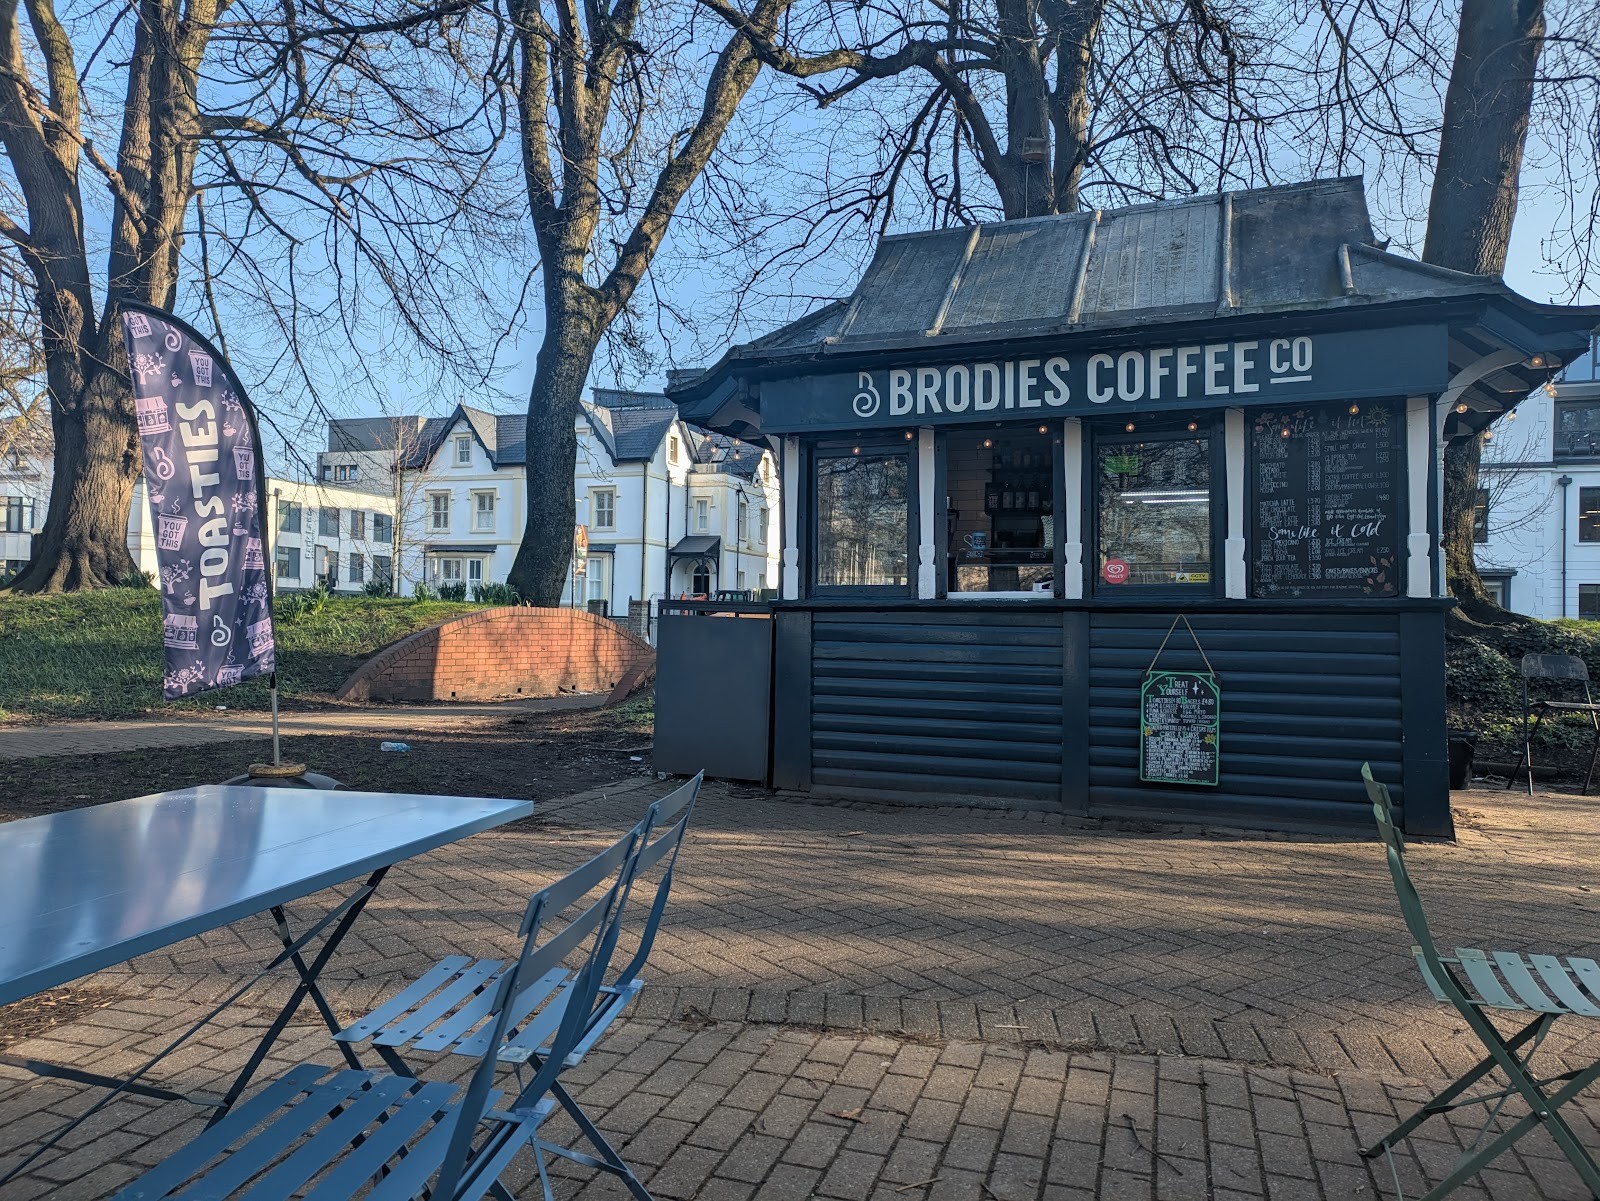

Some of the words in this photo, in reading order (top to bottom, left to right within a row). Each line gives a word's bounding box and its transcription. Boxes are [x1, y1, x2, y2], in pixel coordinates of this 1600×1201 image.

[131, 325, 150, 335] THIS
[195, 357, 209, 367] YOU
[196, 367, 210, 376] GOT
[889, 356, 1071, 416] BRODIES
[1086, 340, 1260, 404] COFFEE
[1269, 336, 1313, 374] CO
[196, 376, 210, 384] THIS
[176, 398, 233, 610] TOASTIES
[164, 521, 180, 530] YOU
[1268, 526, 1296, 540] Some
[1298, 526, 1319, 540] like
[1331, 524, 1344, 538] it
[1351, 521, 1381, 538] Cold
[162, 530, 179, 538] GOT
[161, 538, 178, 548] THIS
[1166, 676, 1189, 688] TREAT
[1157, 684, 1188, 696] YOURSELF
